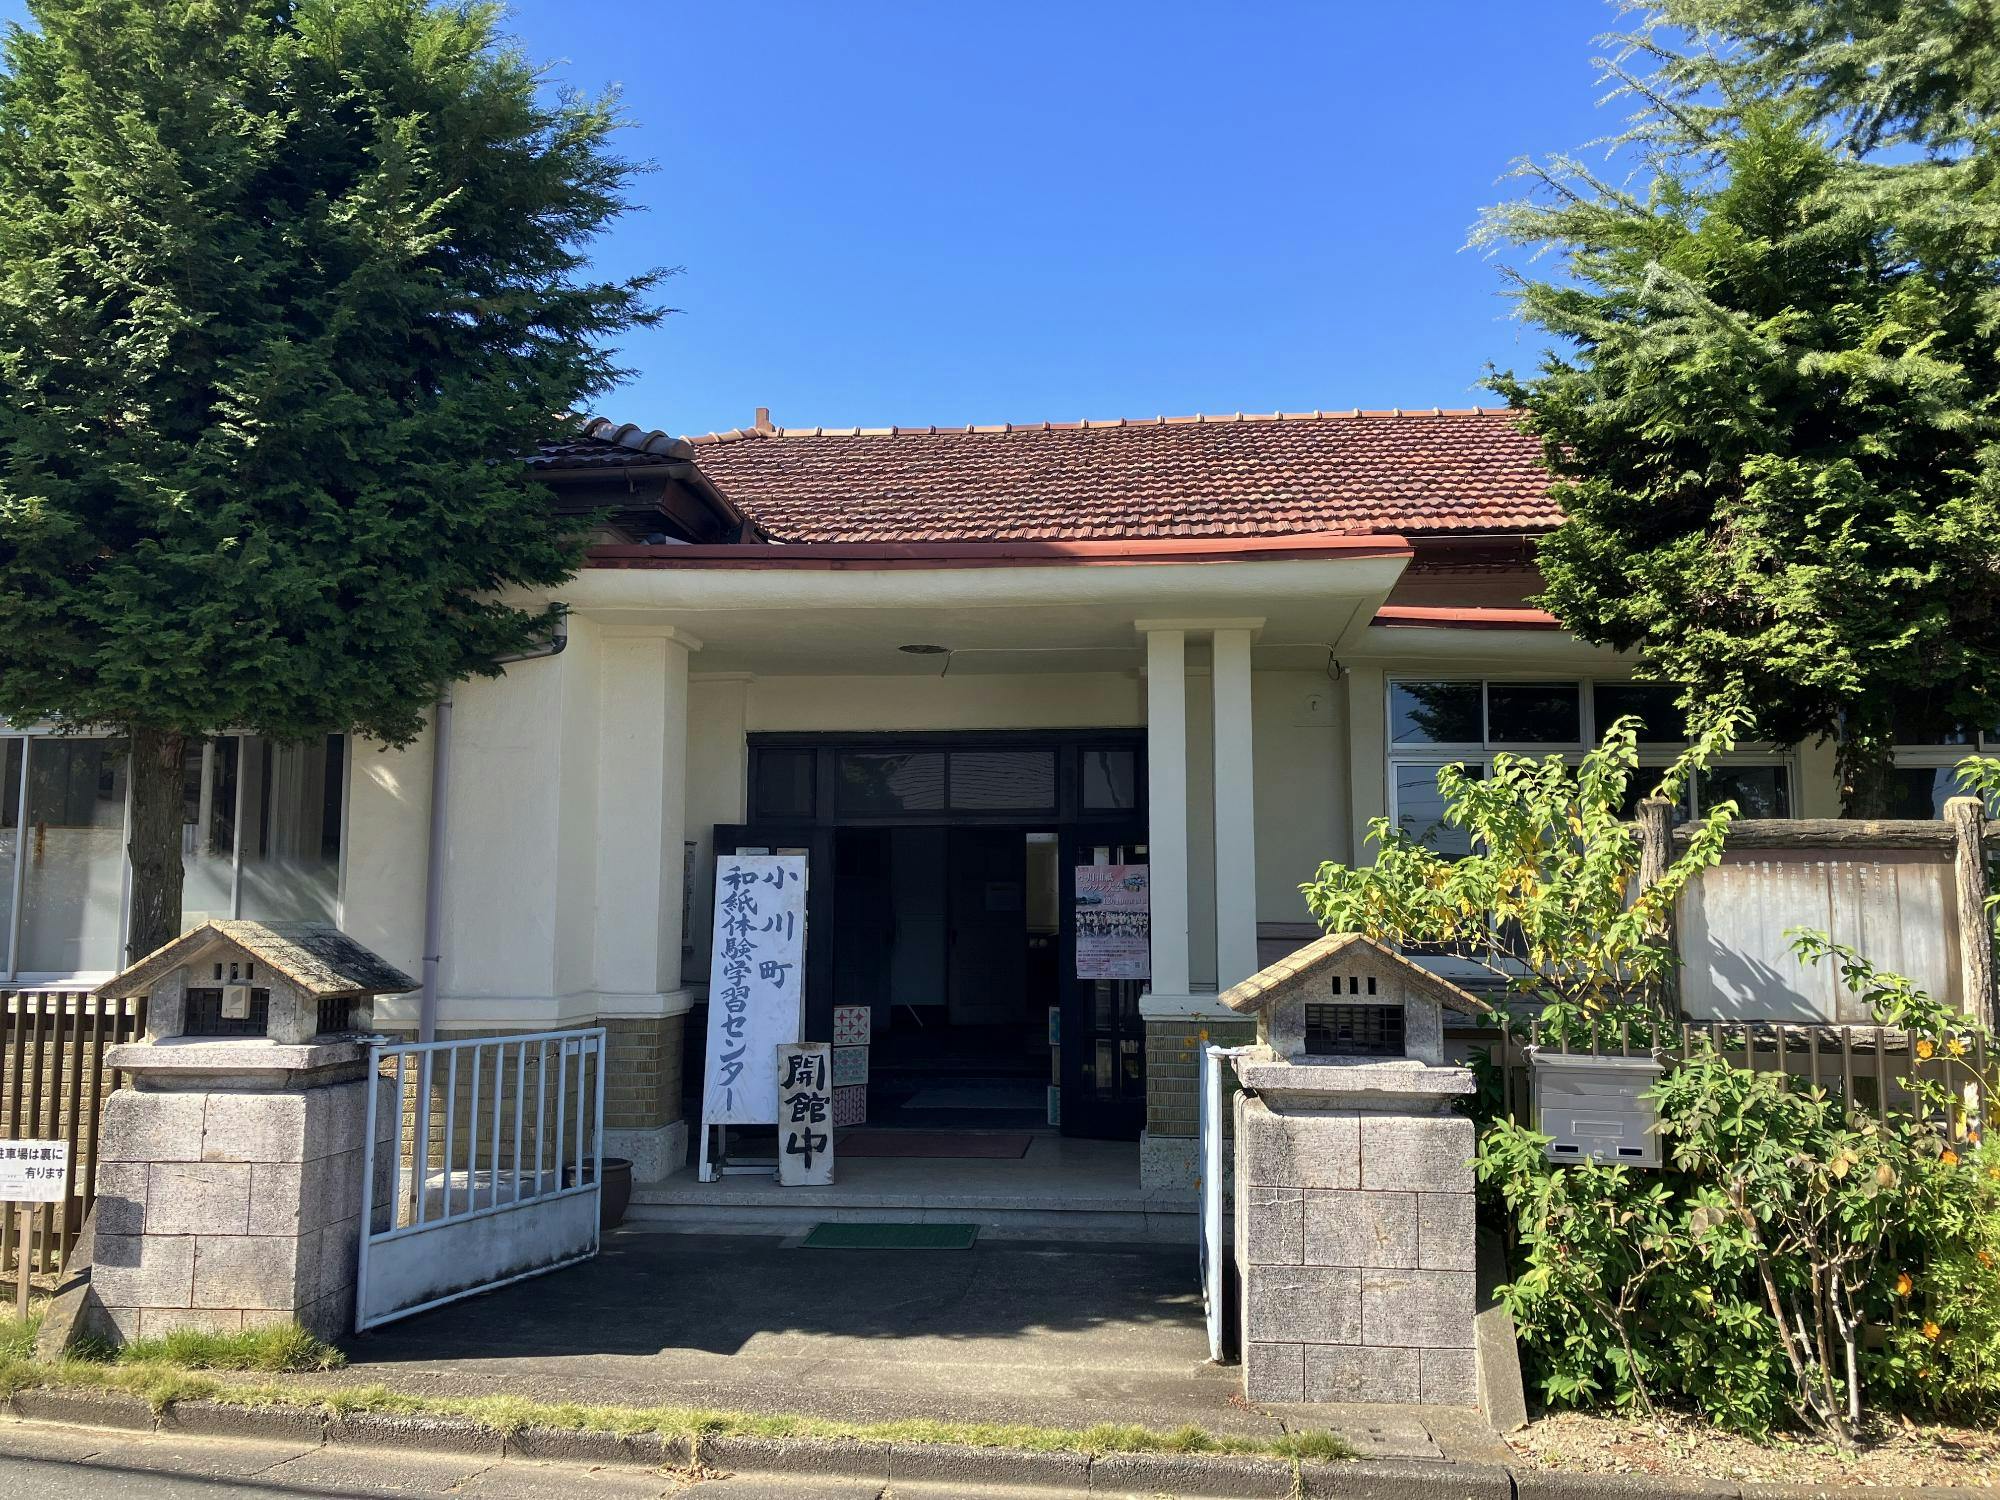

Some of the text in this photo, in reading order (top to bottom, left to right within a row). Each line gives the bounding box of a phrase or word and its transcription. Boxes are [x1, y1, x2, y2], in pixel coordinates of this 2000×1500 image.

[759, 866, 798, 989] 小川町
[720, 866, 758, 1111] 和紙体験学習センター
[780, 1054, 830, 1169] 開館中
[25, 1167, 65, 1179] 有ります
